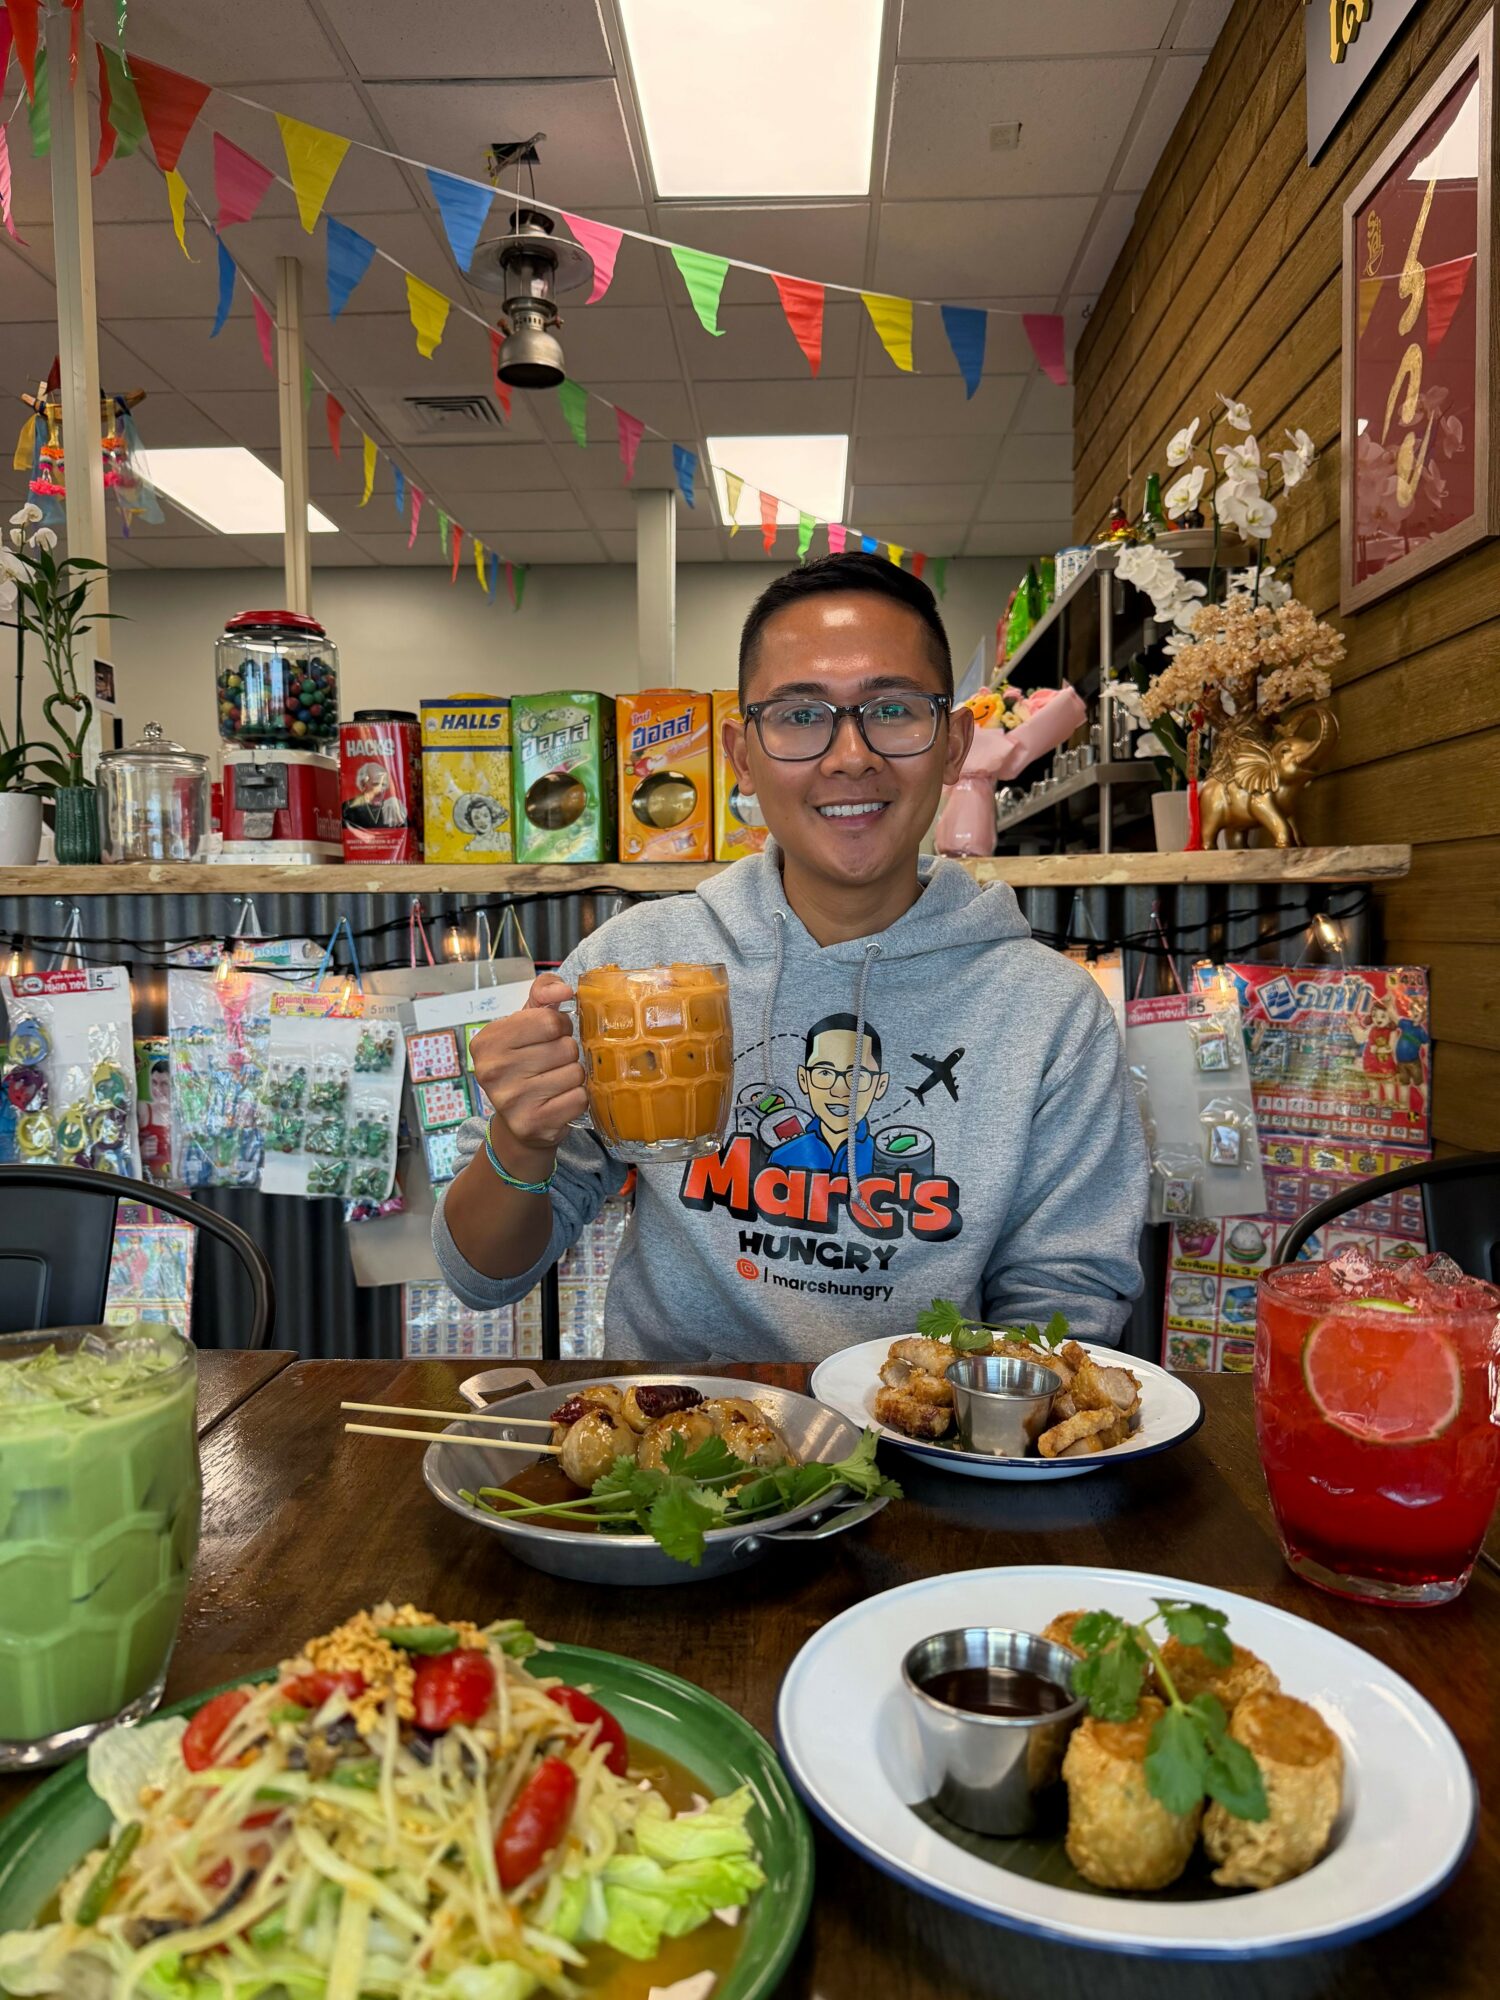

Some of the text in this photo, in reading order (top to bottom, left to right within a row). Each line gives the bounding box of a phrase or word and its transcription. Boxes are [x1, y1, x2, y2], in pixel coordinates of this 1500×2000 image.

[441, 714, 502, 730] HALLS
[521, 714, 592, 763] ฮอลล์
[631, 707, 694, 751] ฮอลล์
[96, 975, 104, 987] 5
[1196, 1000, 1205, 1013] 5
[680, 1133, 962, 1241] Marc's
[738, 1230, 898, 1273] HUNGRY
[773, 1274, 894, 1302] marcshungry
